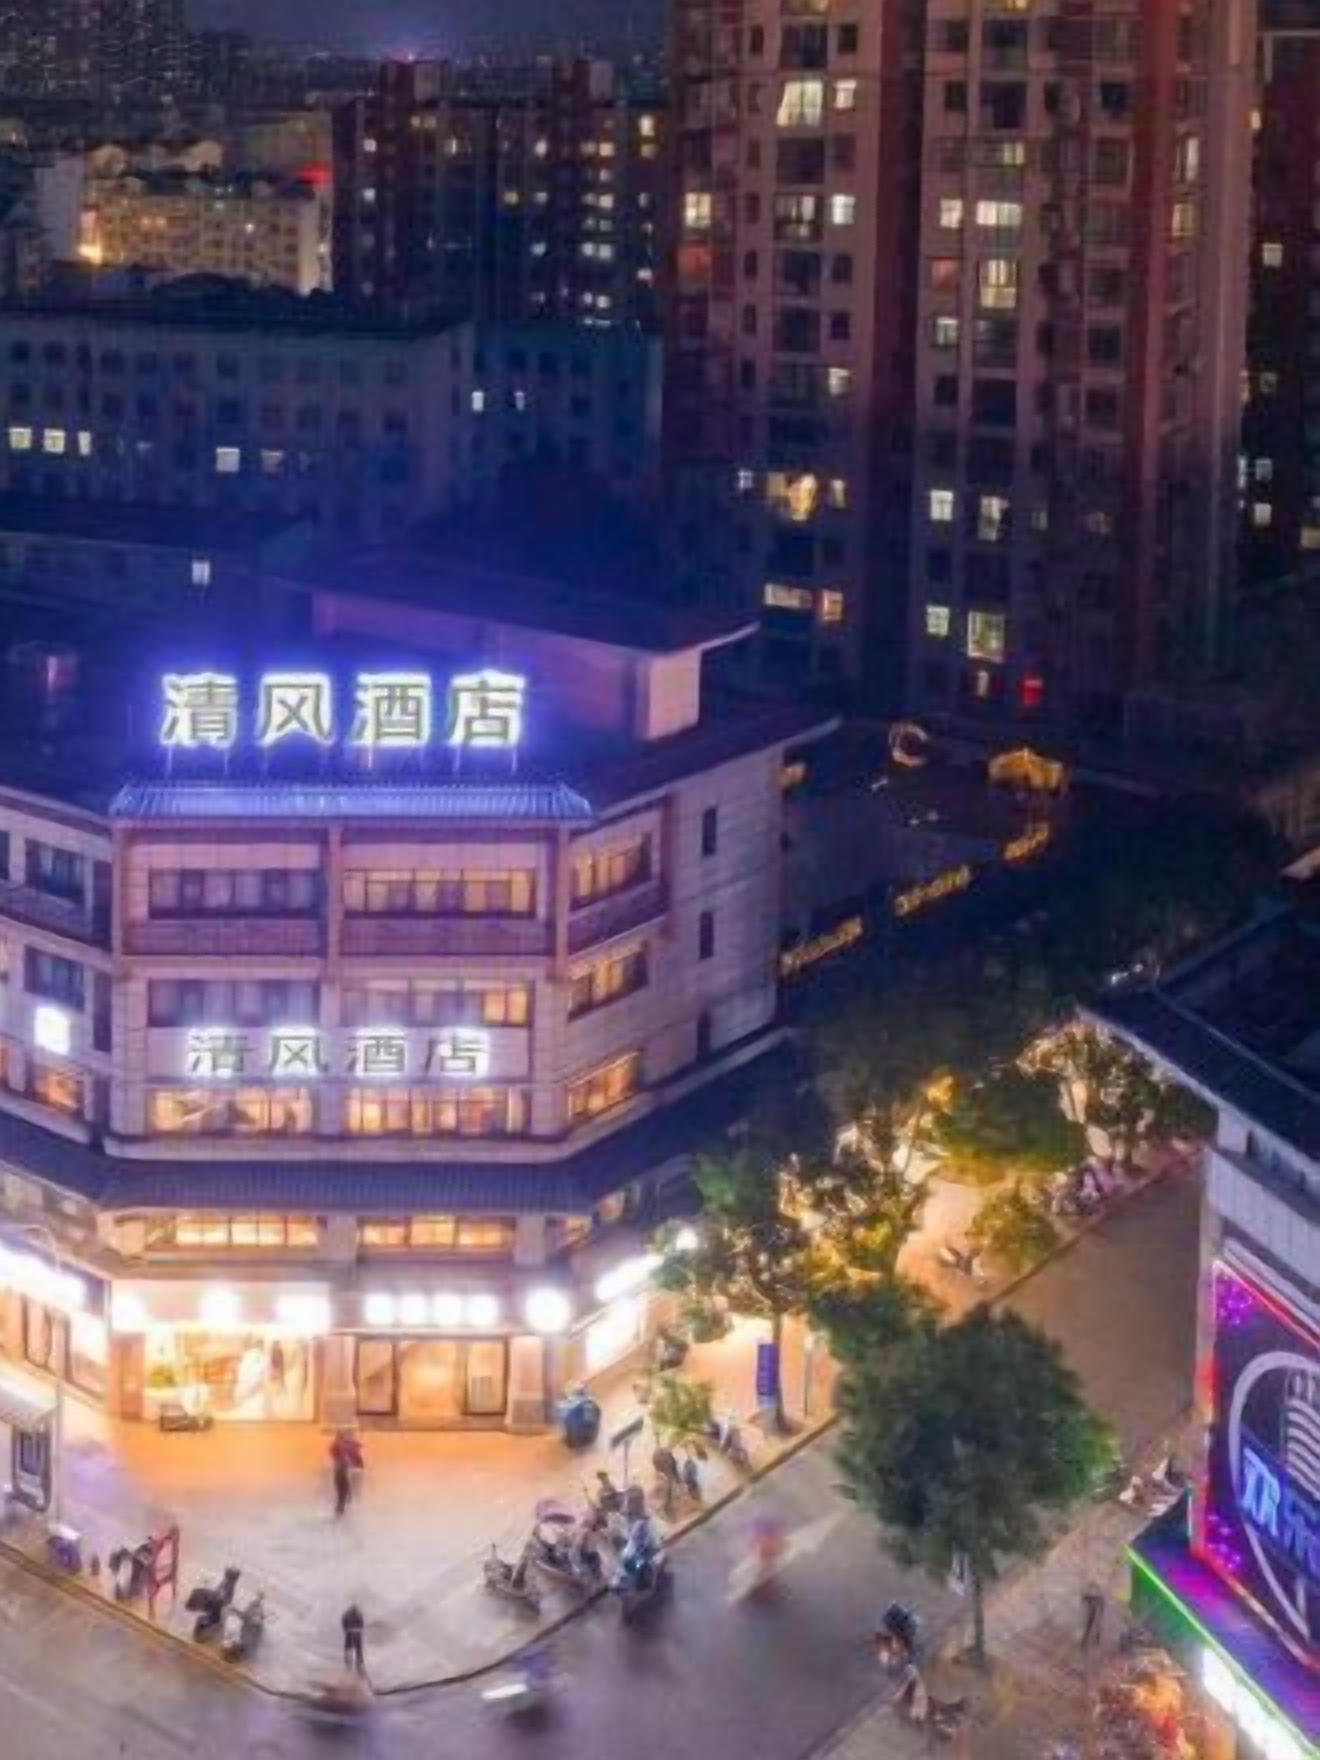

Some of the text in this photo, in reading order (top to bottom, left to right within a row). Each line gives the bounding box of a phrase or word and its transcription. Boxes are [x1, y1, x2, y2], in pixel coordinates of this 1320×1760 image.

[160, 672, 525, 746] 清风酒店
[188, 1028, 491, 1075] 清风酒店
